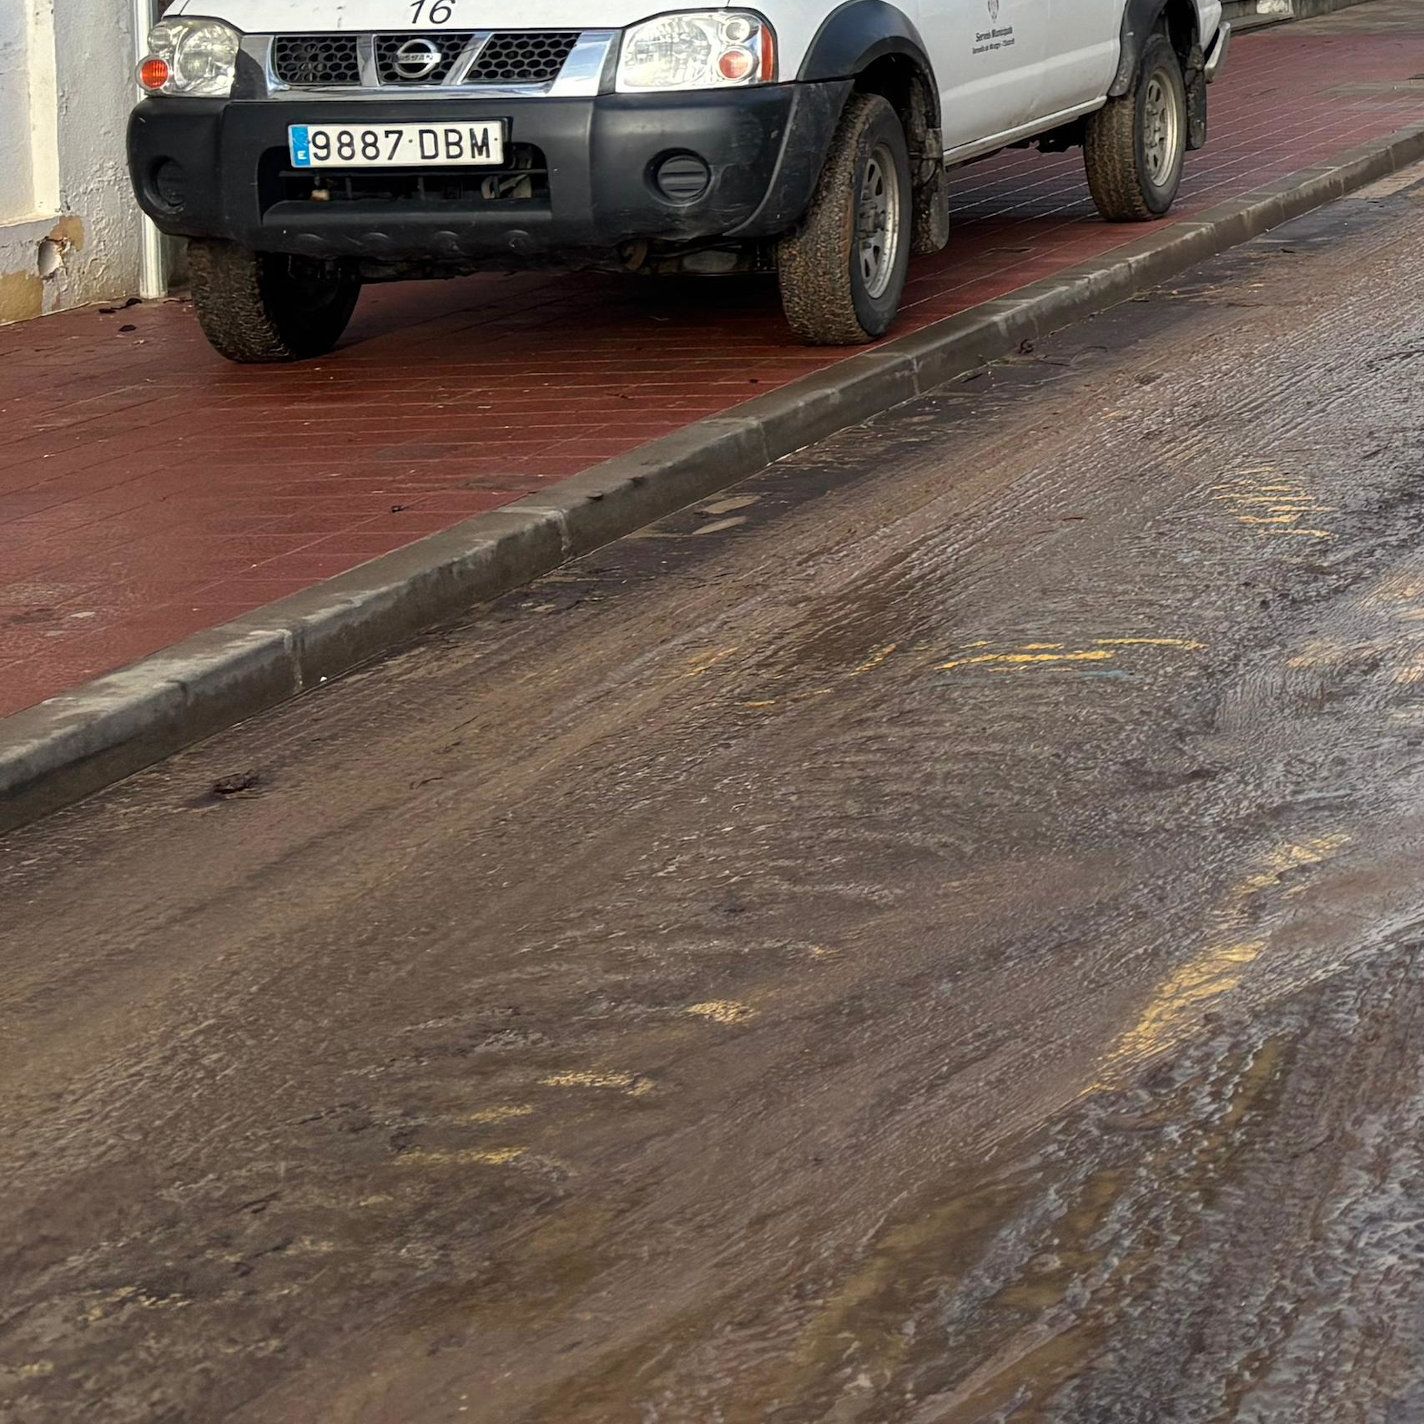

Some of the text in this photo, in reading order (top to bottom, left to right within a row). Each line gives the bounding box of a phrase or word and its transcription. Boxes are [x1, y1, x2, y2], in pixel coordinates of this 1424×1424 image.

[297, 150, 307, 160] E
[311, 127, 491, 161] 9887 DBM
